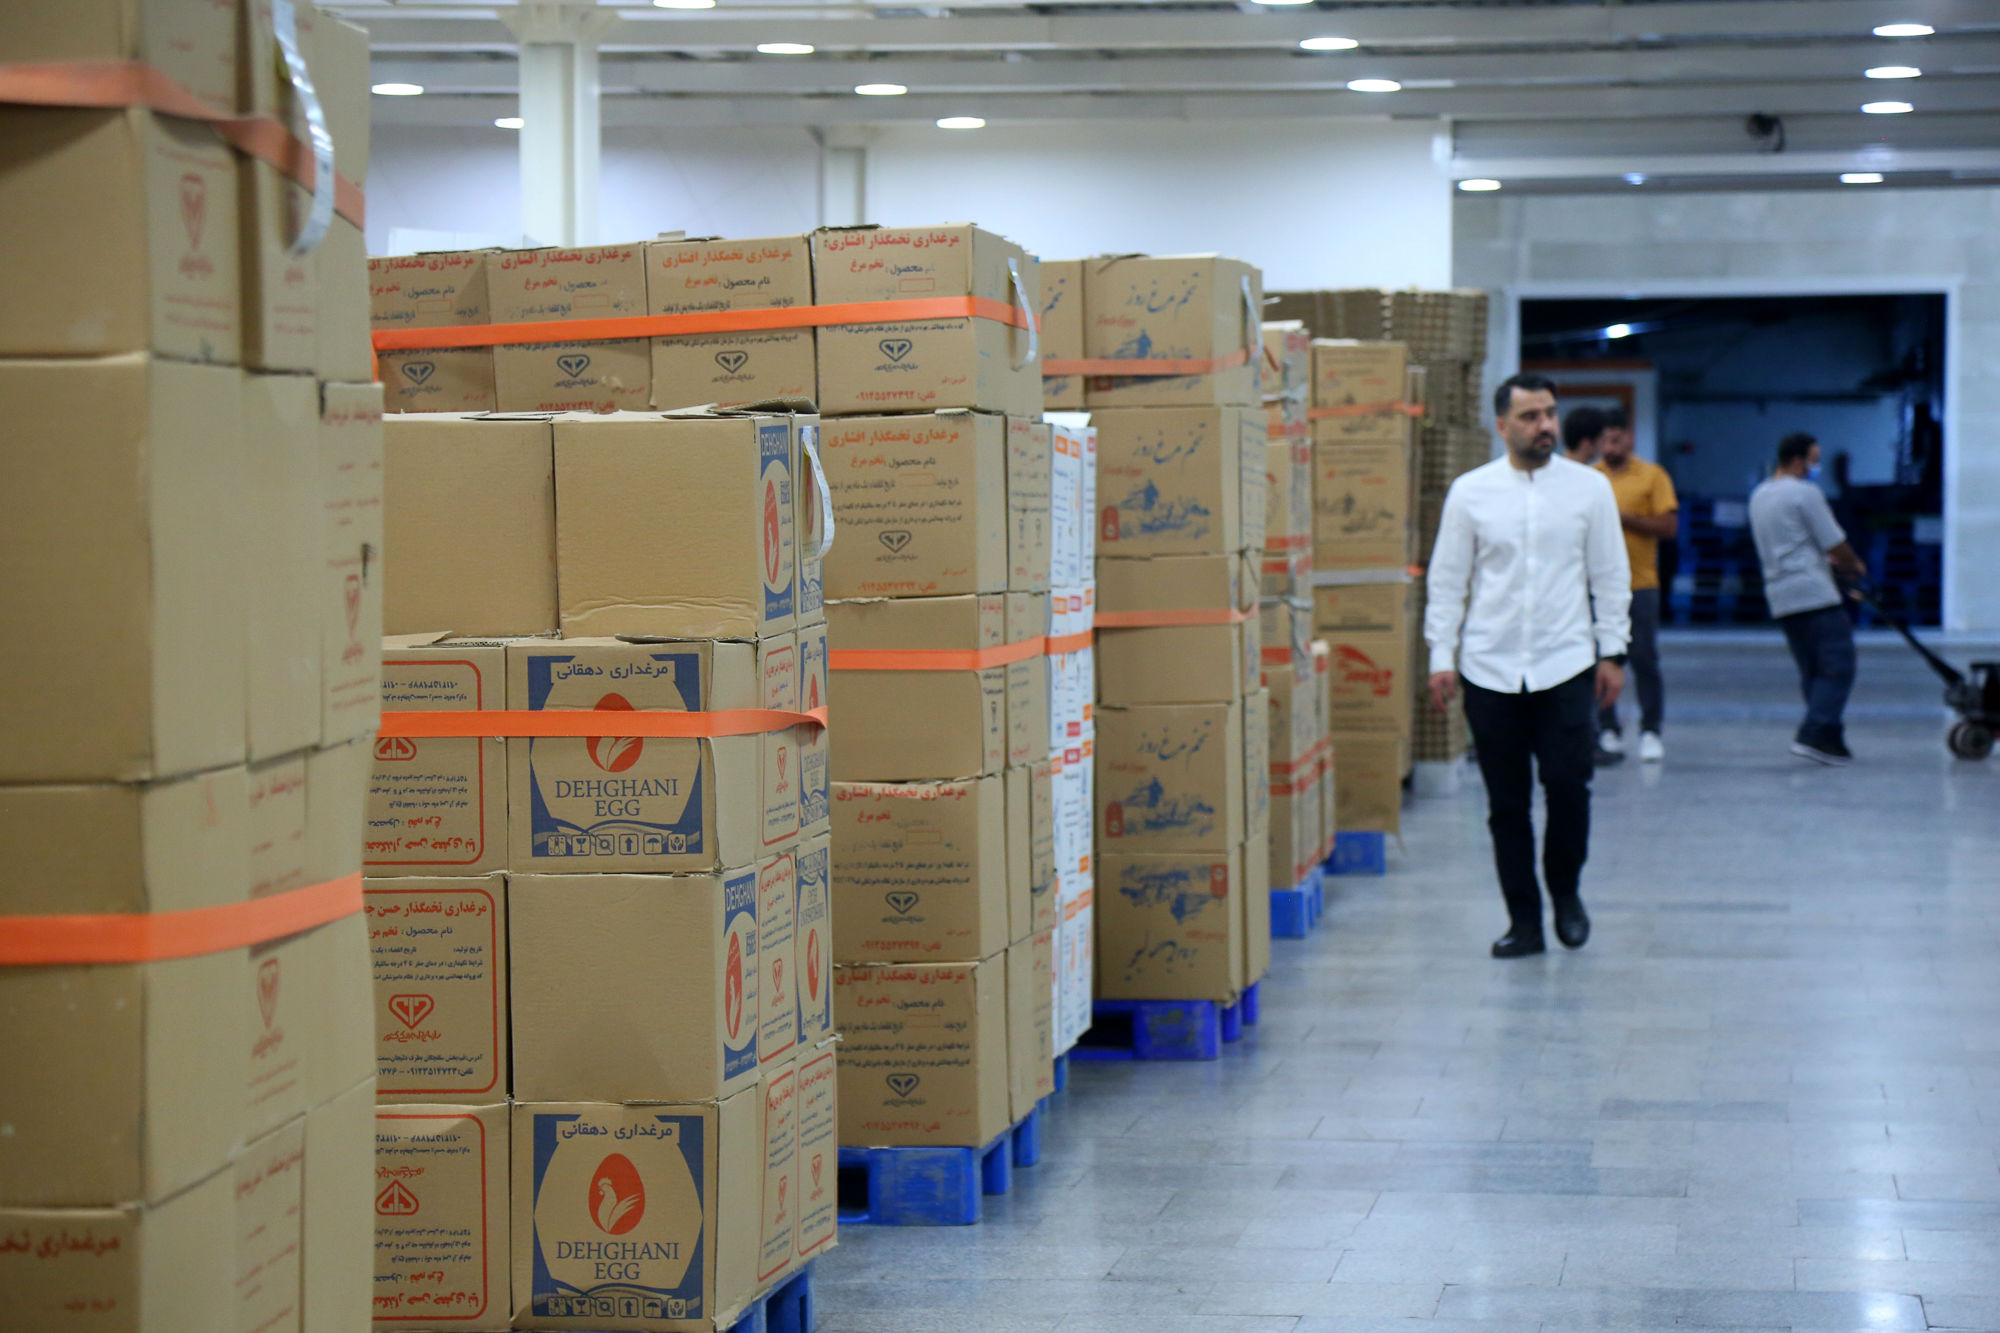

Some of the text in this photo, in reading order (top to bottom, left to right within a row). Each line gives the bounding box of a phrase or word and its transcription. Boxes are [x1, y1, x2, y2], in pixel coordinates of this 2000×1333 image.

[869, 233, 912, 250] تخمگذار
[914, 232, 960, 248] مرغداری
[585, 248, 632, 265] مرغداری
[868, 429, 911, 447] تخمگذار
[912, 429, 960, 445] مرغداری
[556, 662, 669, 679] مرغداری دهقانی
[555, 778, 679, 799] DEHGHANI
[594, 799, 641, 817] EGG
[377, 903, 401, 918] حسن
[403, 900, 443, 918] تخمگذار
[444, 900, 488, 918] مرغداری
[369, 929, 381, 940] مر
[382, 926, 398, 938] تخم
[440, 926, 454, 939] نام
[919, 968, 966, 985] مرغداری
[561, 1122, 673, 1140] مرغداری دهقانی
[556, 1241, 680, 1260] DEHGHANI
[594, 1262, 641, 1280] EGG
